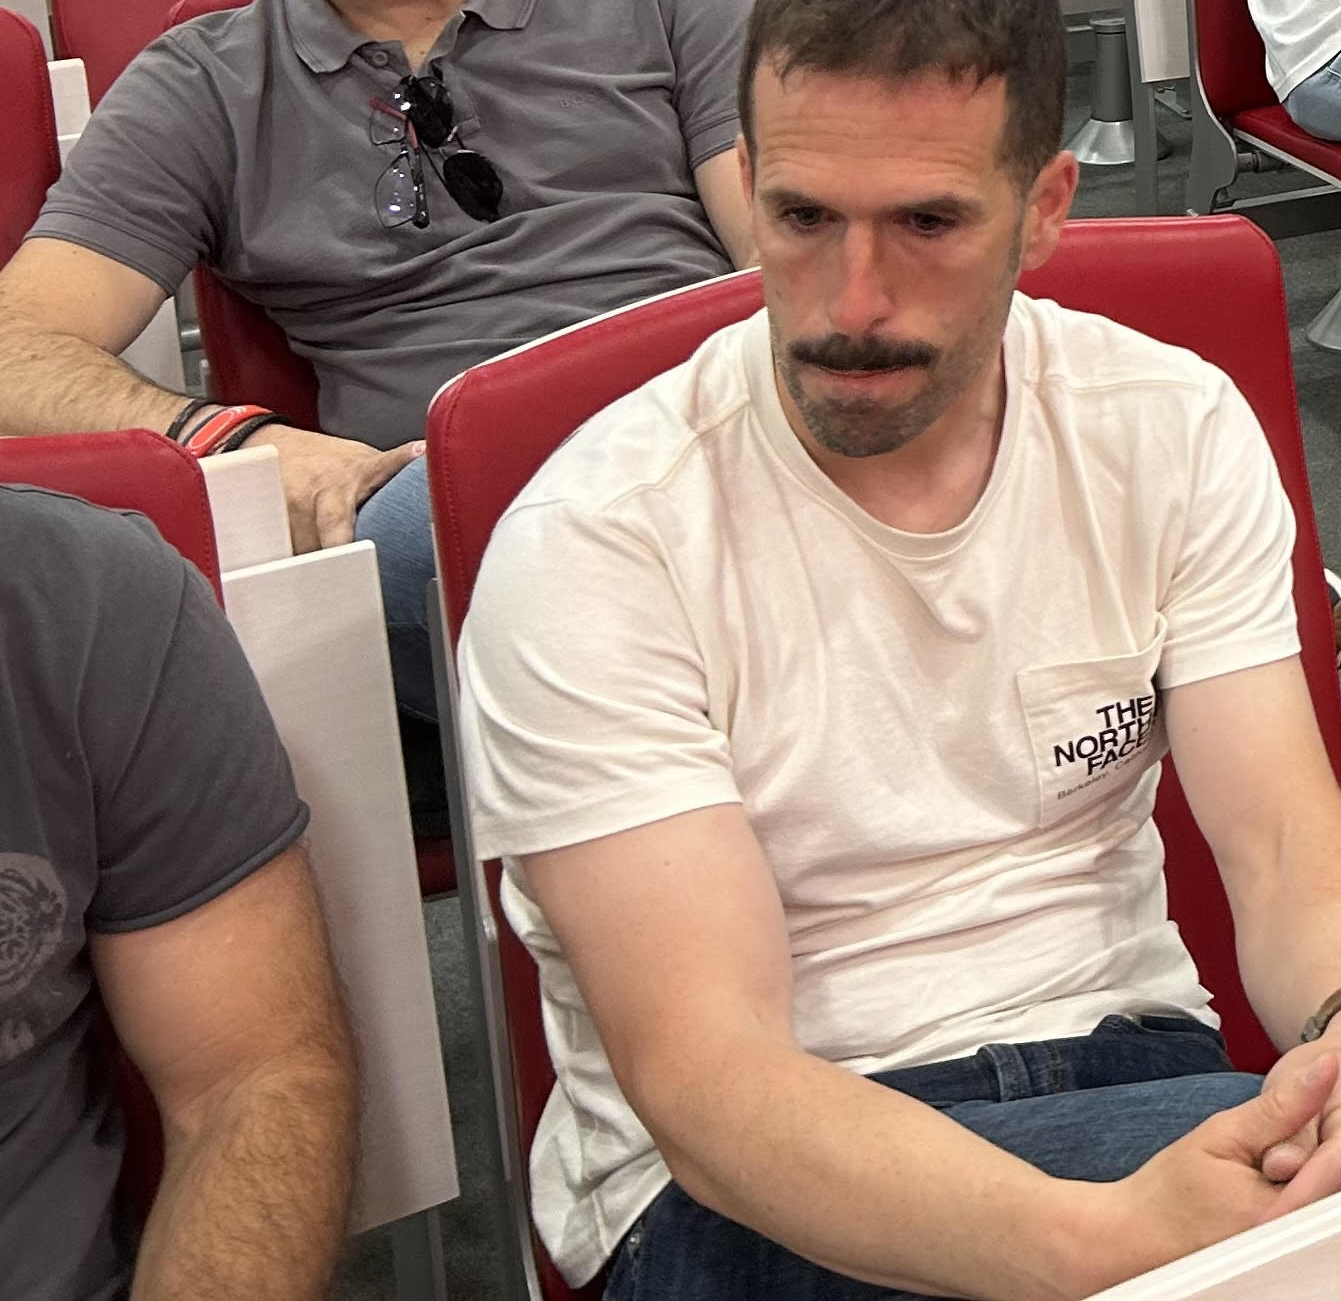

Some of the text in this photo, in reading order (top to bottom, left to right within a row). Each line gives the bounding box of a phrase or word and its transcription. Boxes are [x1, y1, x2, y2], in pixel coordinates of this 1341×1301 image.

[1096, 694, 1154, 729] THE
[1053, 715, 1153, 767] NORTH
[1087, 735, 1148, 776] FACE
